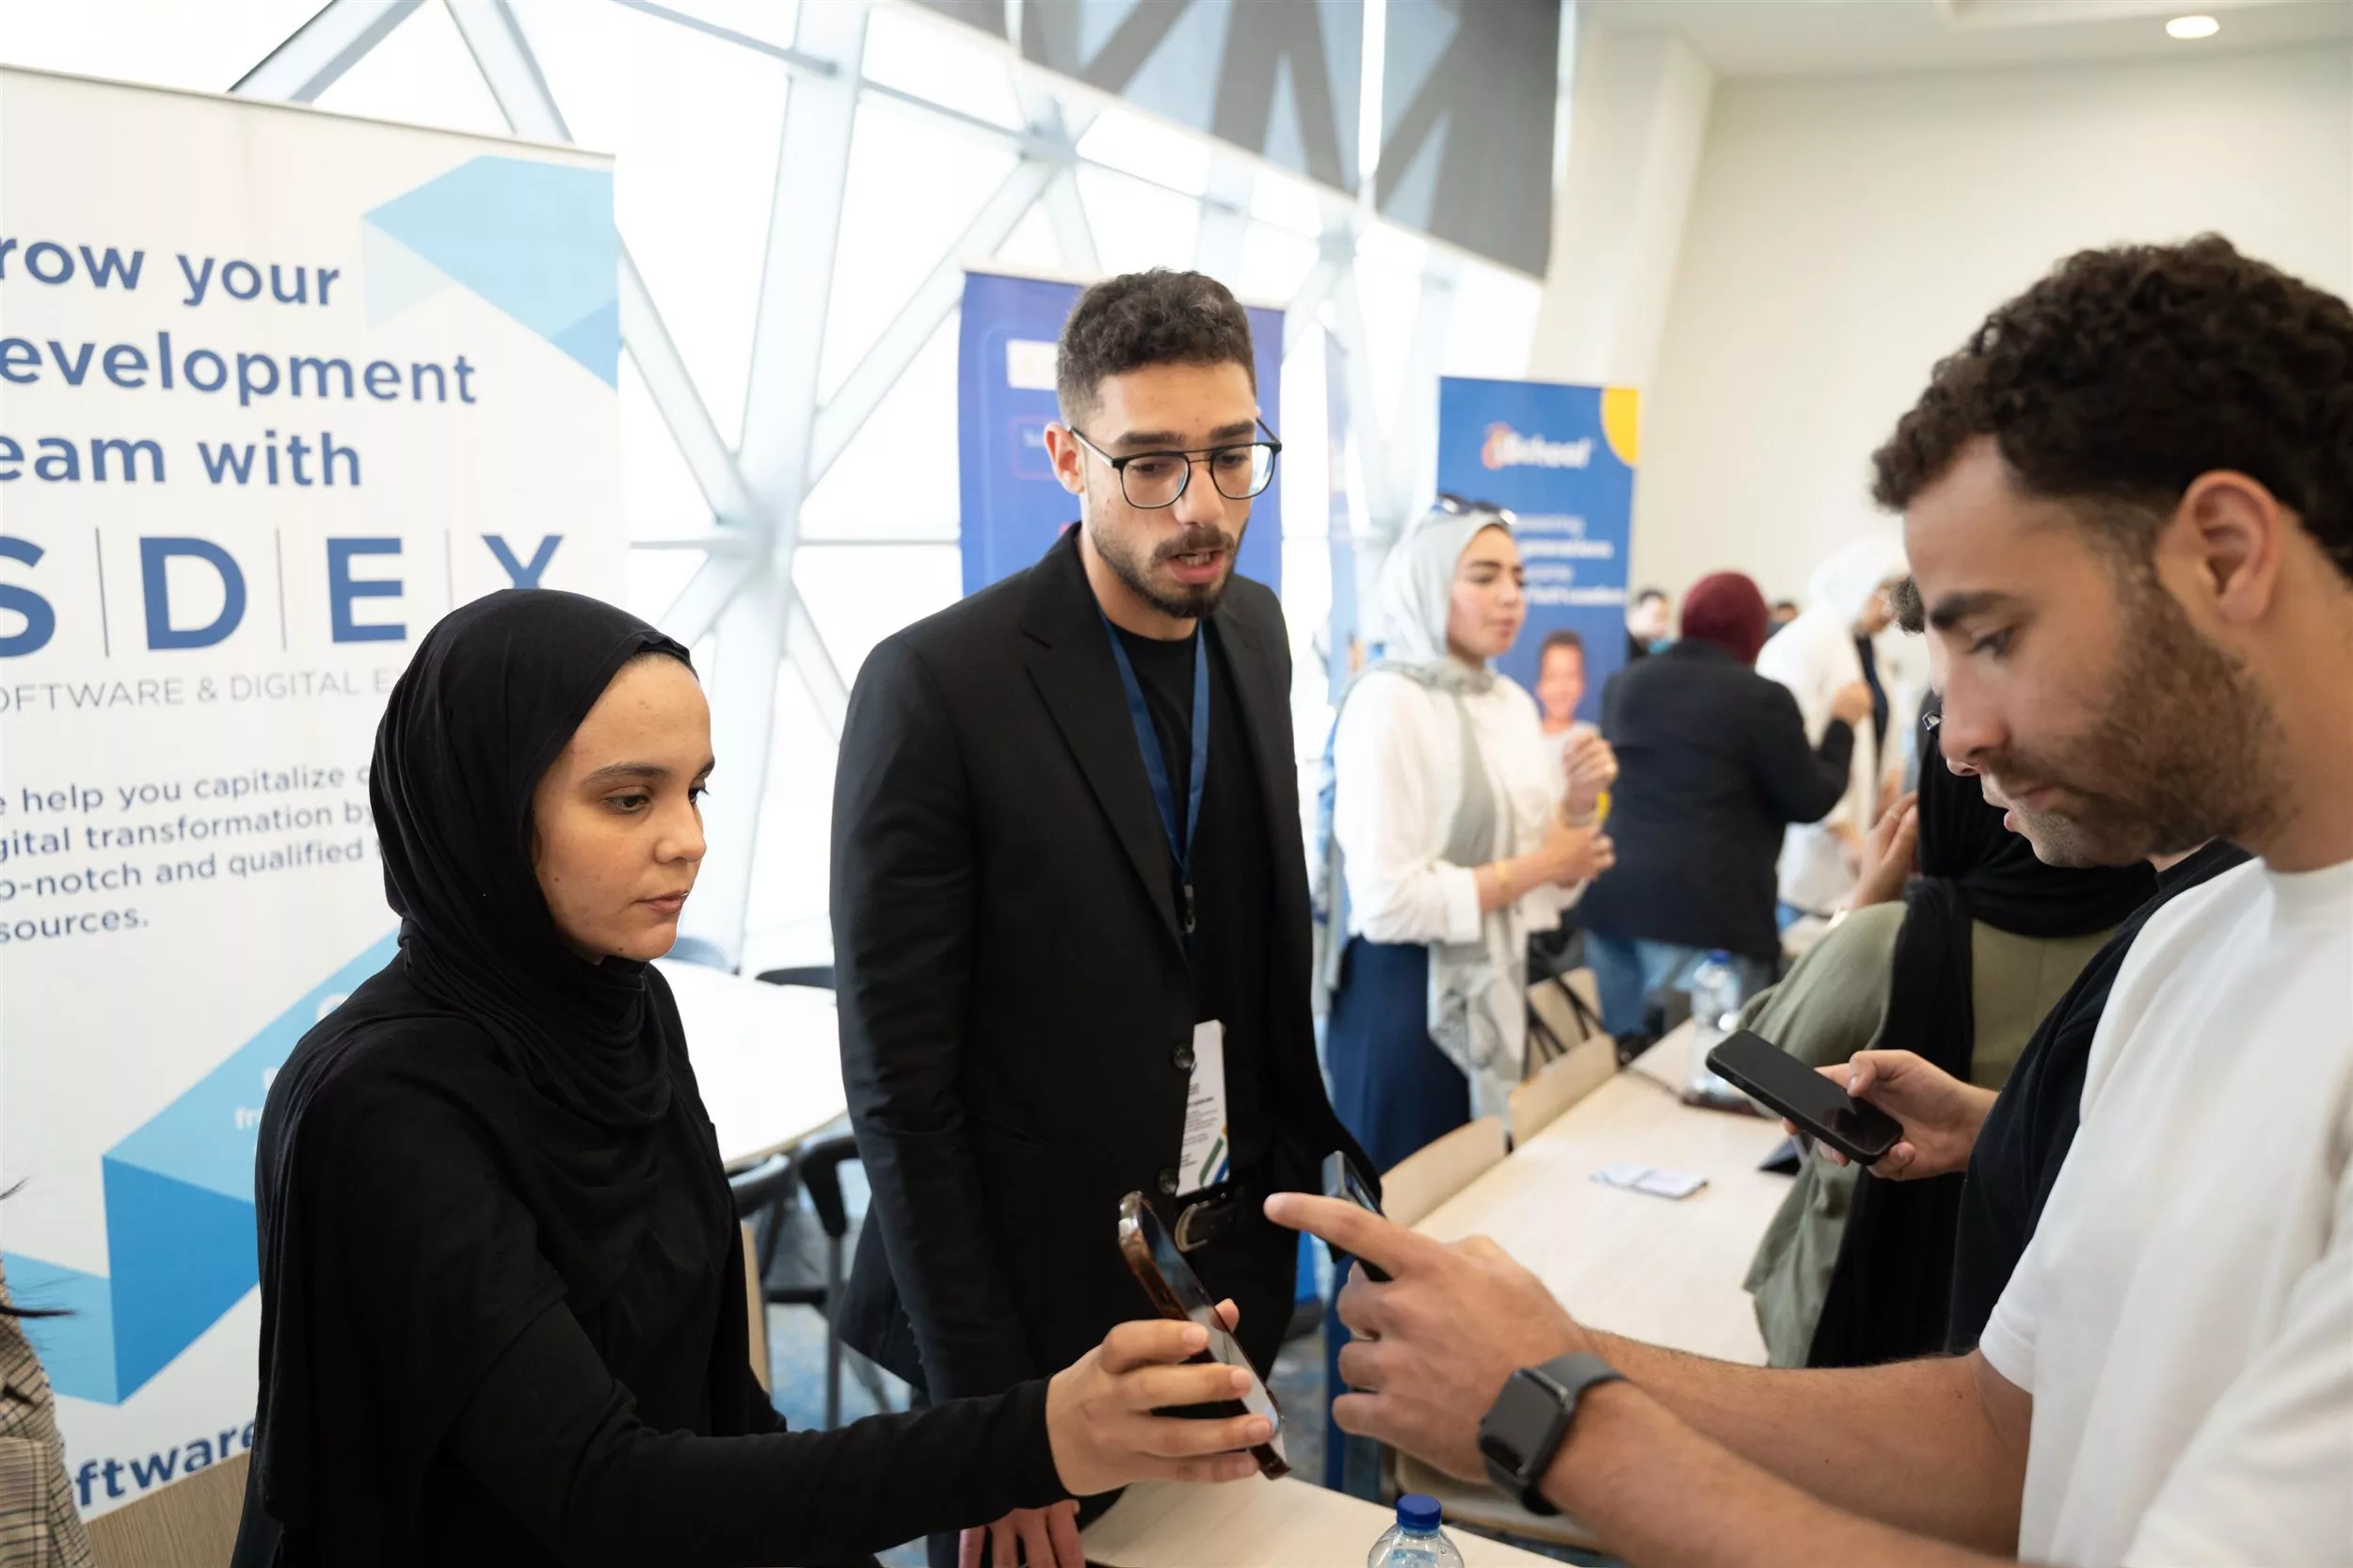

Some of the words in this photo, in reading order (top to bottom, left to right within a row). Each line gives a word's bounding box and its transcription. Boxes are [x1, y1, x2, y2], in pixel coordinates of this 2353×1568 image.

[177, 251, 341, 306] your
[0, 331, 477, 406] evelopment
[0, 435, 166, 482] eam
[198, 430, 361, 487] with
[197, 677, 218, 702] &
[232, 670, 360, 702] DIGITAL
[23, 782, 104, 814] help
[119, 782, 181, 811] you
[194, 765, 345, 802] capitalize
[86, 804, 332, 851] transformation
[156, 854, 216, 884] and
[230, 838, 363, 878] qualified
